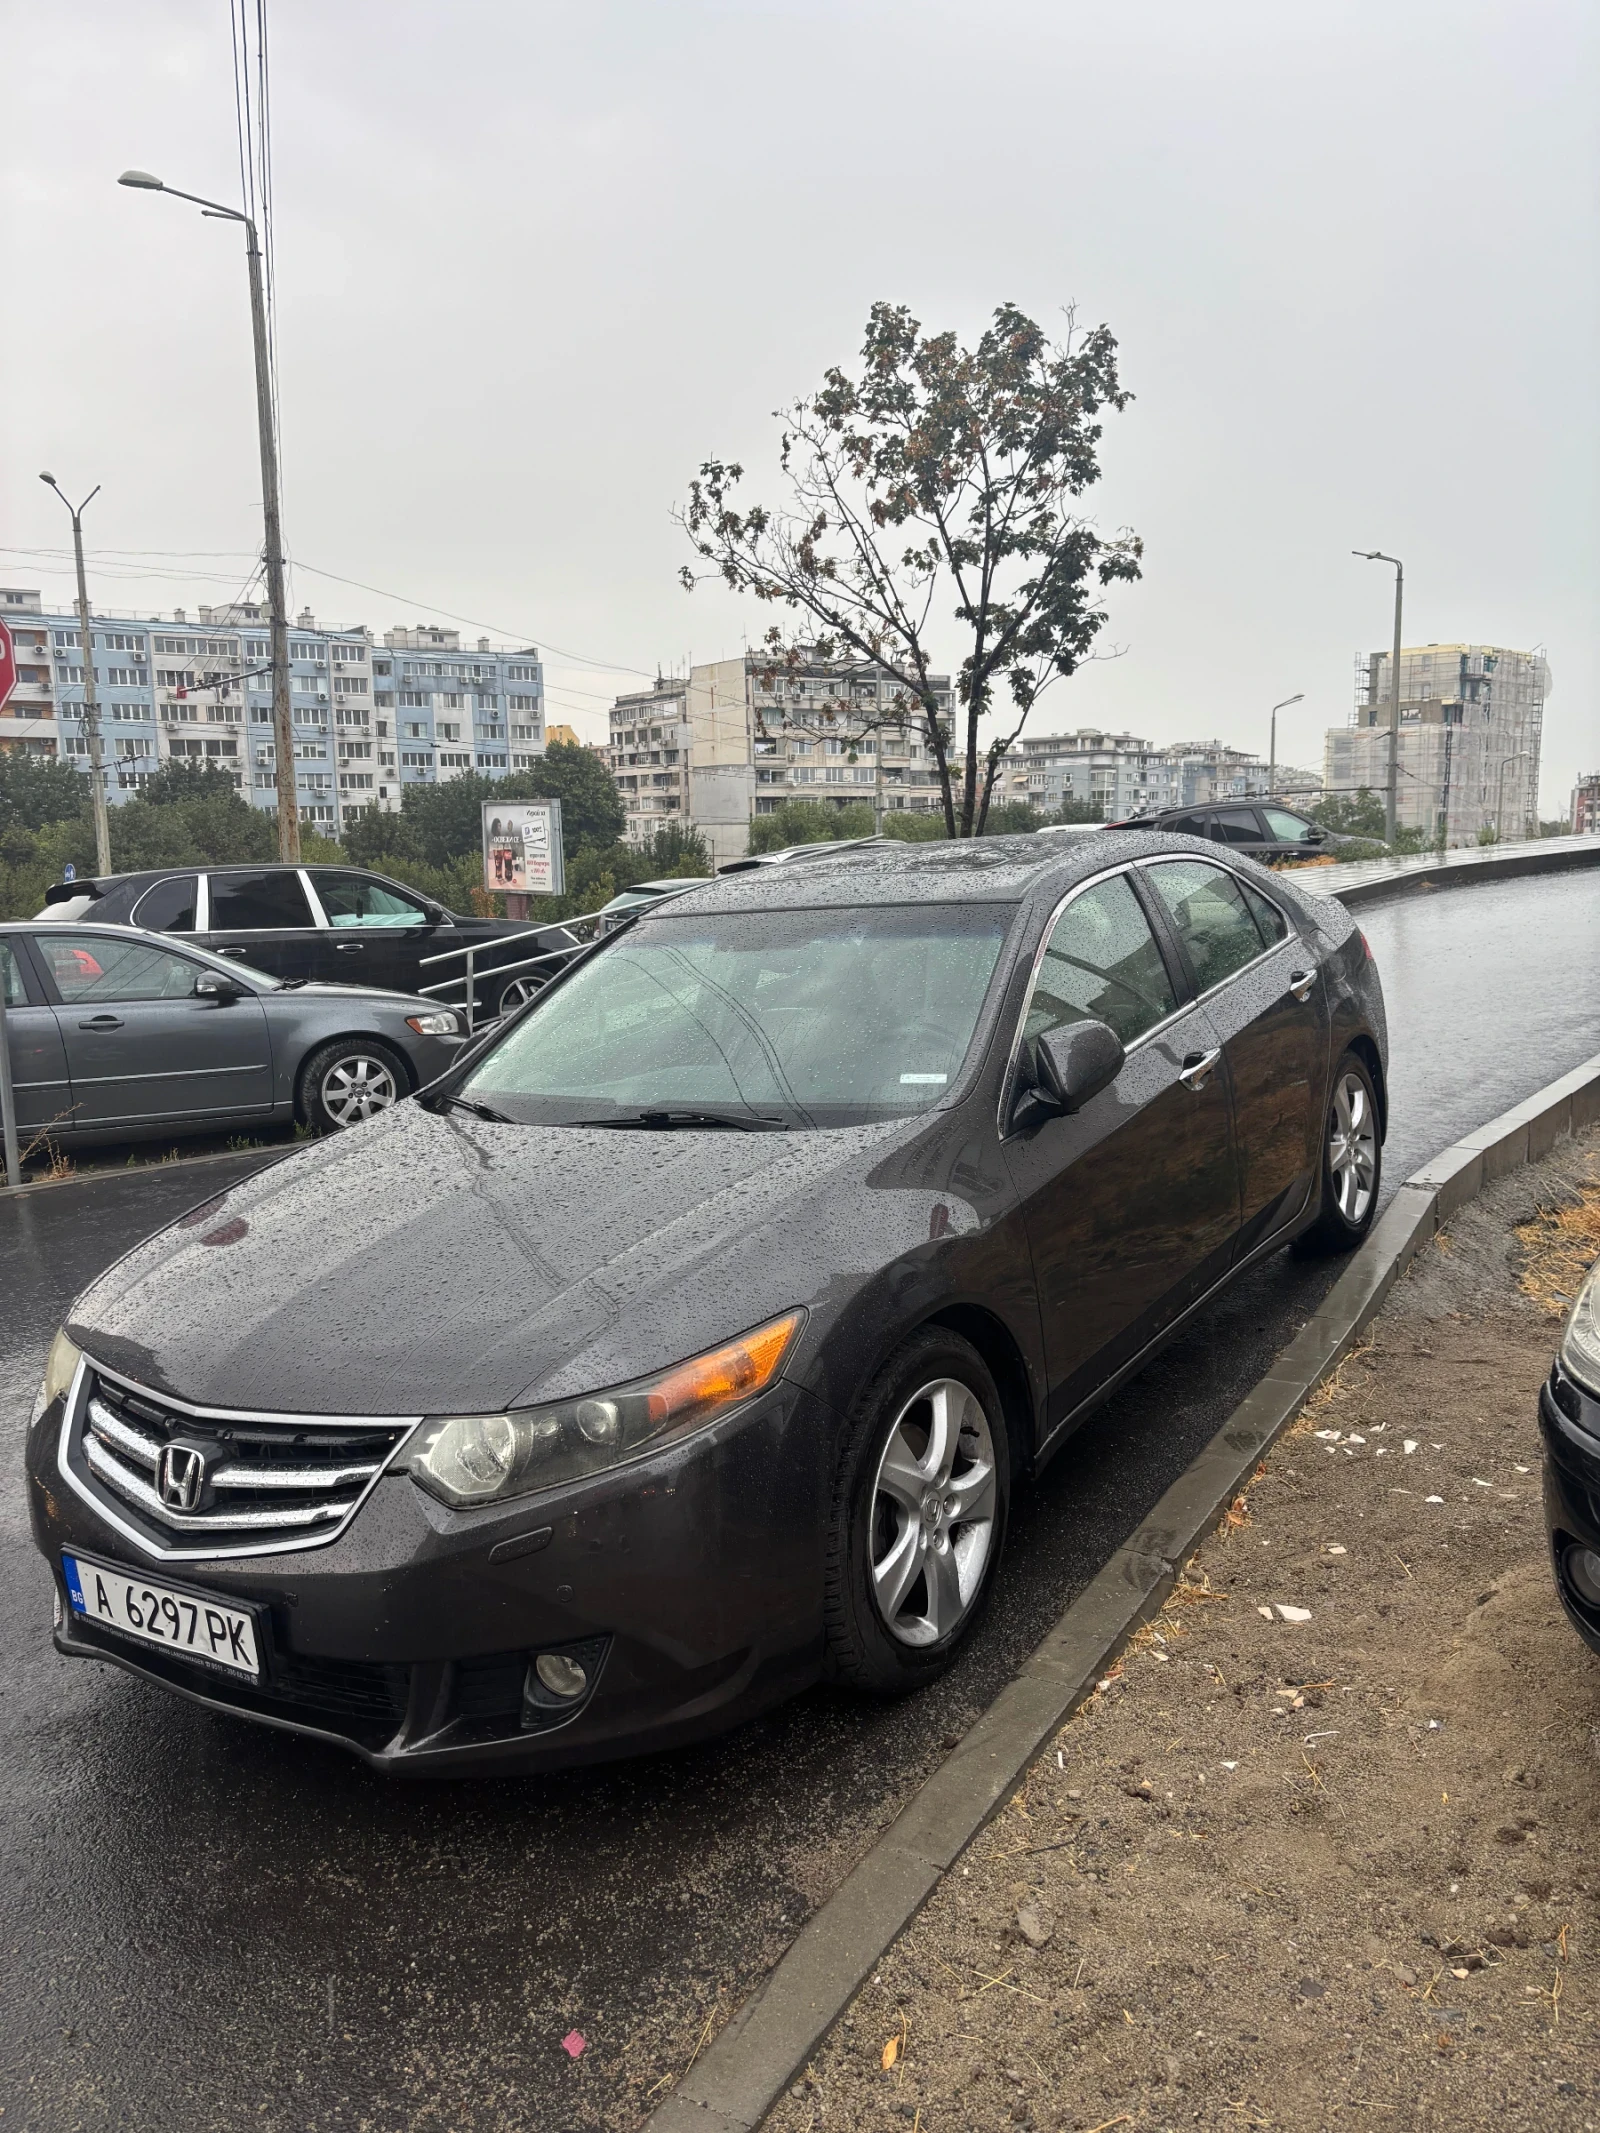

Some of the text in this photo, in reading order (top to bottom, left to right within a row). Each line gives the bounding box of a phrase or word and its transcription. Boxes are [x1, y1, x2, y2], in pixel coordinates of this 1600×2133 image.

[71, 1589, 83, 1604] BG
[96, 1573, 253, 1667] A 6297 PK
